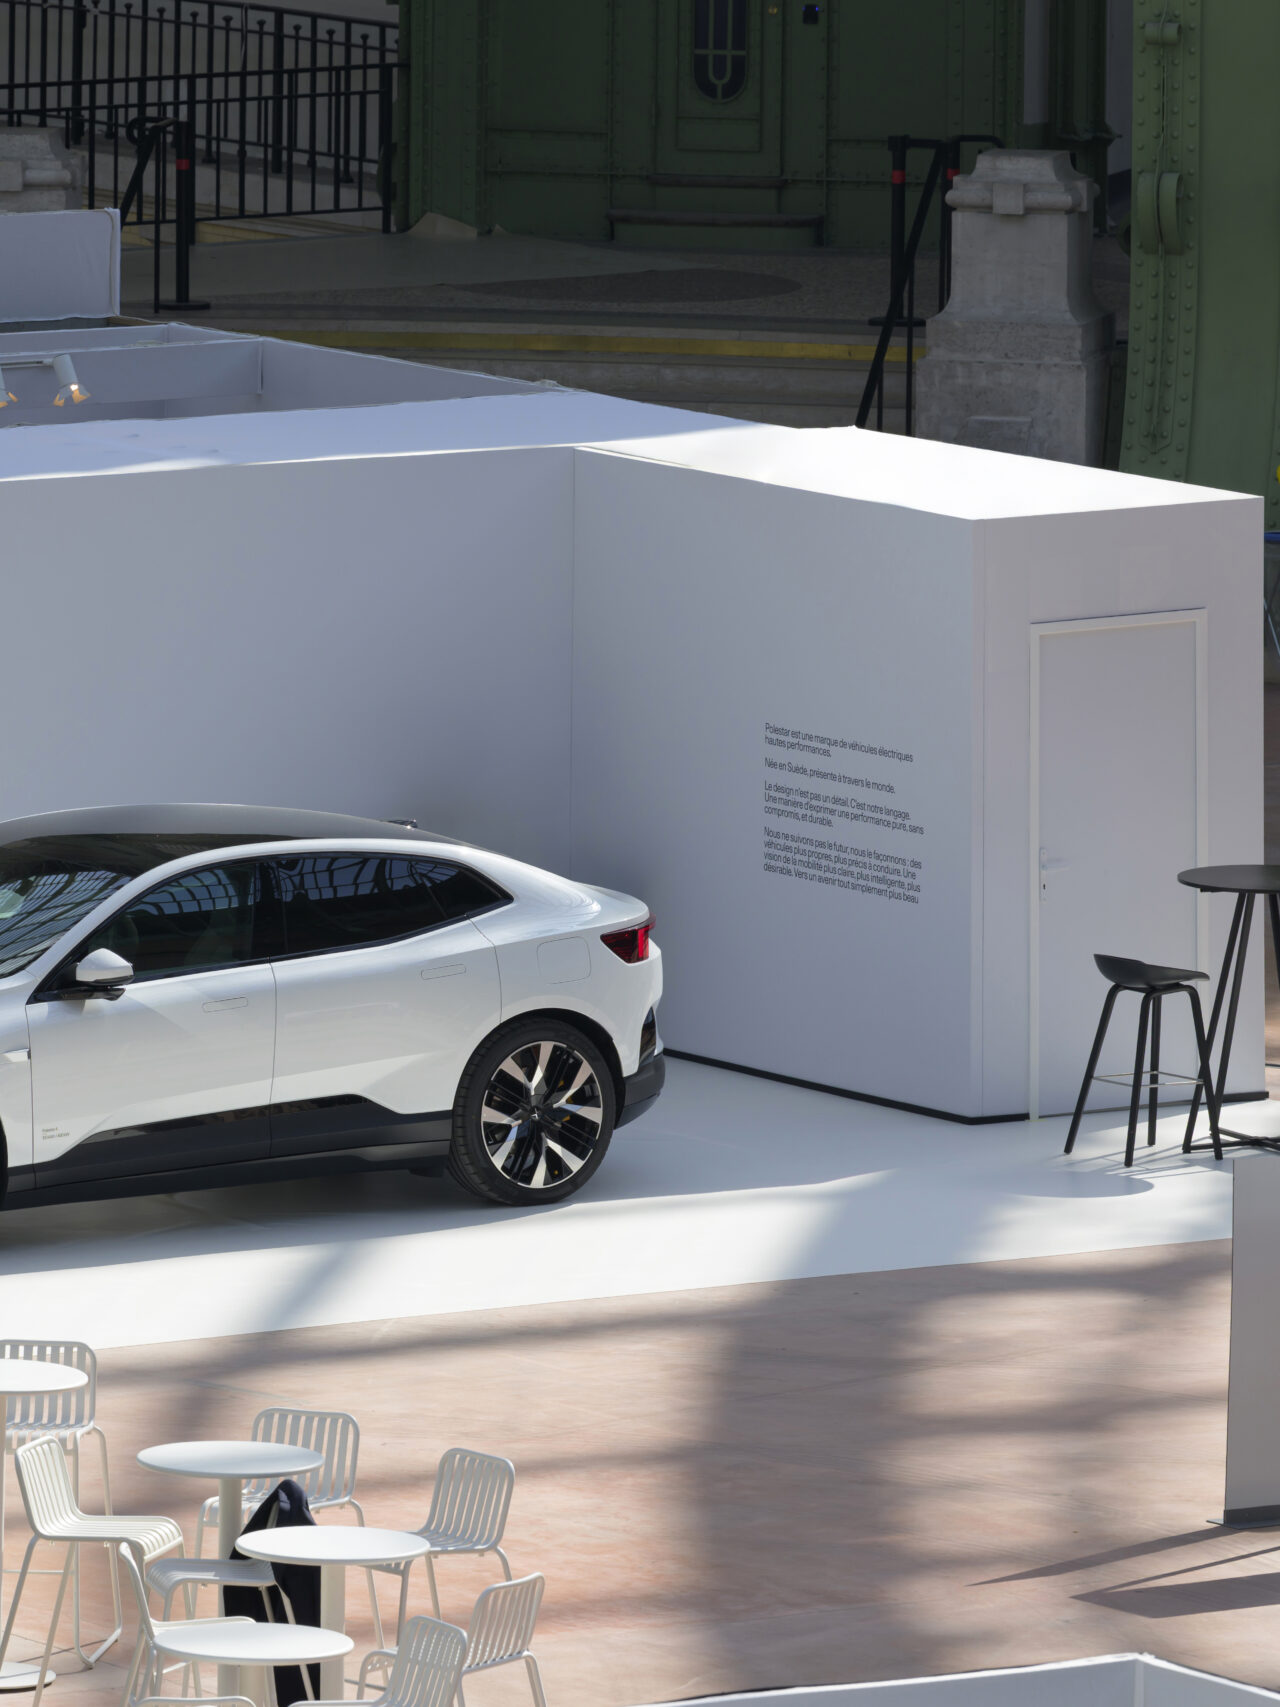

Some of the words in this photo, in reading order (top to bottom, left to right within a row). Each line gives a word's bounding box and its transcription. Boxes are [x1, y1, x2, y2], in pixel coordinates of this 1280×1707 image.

[764, 735, 787, 748] hautes
[765, 722, 790, 737] Polestar
[791, 730, 801, 740] est
[801, 732, 814, 743] une
[814, 735, 839, 748] marque
[839, 738, 848, 750] de
[778, 761, 787, 772] en
[842, 775, 865, 788] travers
[865, 778, 872, 789] le
[764, 779, 773, 791] Le
[773, 782, 794, 797] design
[809, 791, 821, 802] pas
[822, 795, 831, 804] un
[866, 803, 884, 815] notre
[764, 791, 778, 804] Une
[837, 809, 850, 820] une
[850, 812, 892, 828] performance
[908, 824, 925, 835] sans
[801, 813, 808, 822] et
[764, 826, 781, 840] Nous
[781, 832, 790, 841] ne
[790, 833, 815, 847] suivons
[815, 839, 827, 850] pas
[827, 840, 833, 851] le
[850, 847, 867, 858] nous
[867, 848, 873, 859] le
[910, 858, 922, 870] des
[793, 845, 808, 857] plus
[834, 854, 848, 866] plus
[903, 867, 917, 880] Une
[763, 851, 782, 863] vision
[782, 853, 791, 865] de
[791, 855, 797, 866] la
[823, 863, 837, 875] plus
[856, 870, 871, 882] plus
[907, 881, 921, 893] plus
[793, 867, 809, 880] Vers
[808, 873, 817, 882] un
[817, 875, 838, 887] avenir
[837, 878, 850, 890] tout
[850, 882, 889, 898] simplement
[888, 889, 903, 901] plus
[903, 891, 919, 905] beau
